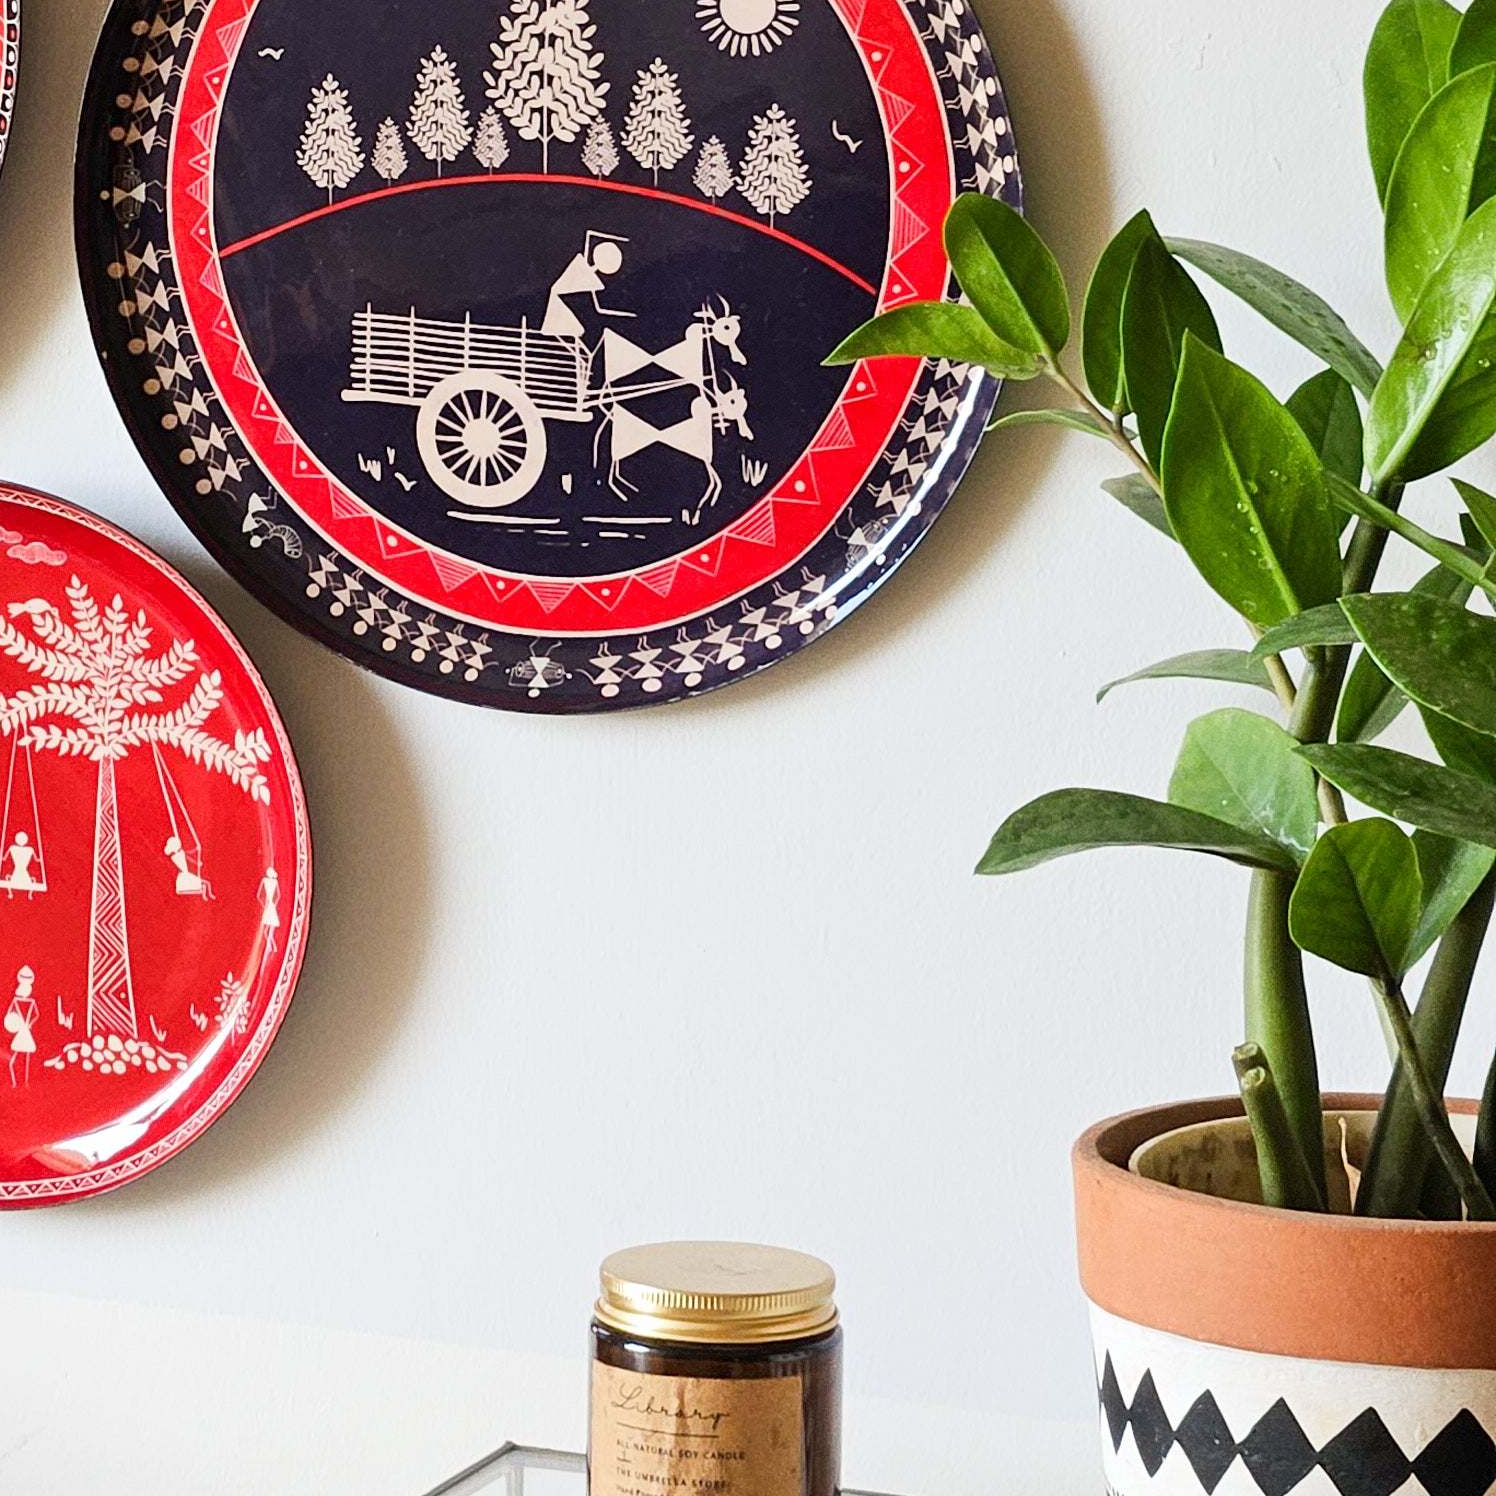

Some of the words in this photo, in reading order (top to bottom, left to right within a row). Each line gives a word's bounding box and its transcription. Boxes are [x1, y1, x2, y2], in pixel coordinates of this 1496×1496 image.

[611, 1383, 730, 1431] Library
[616, 1438, 630, 1449] ALL
[633, 1442, 674, 1458] NATURAL
[678, 1448, 699, 1459] SOY
[703, 1450, 745, 1461] CANDLE
[616, 1466, 631, 1478] THE
[634, 1470, 687, 1487] UMBRELLA
